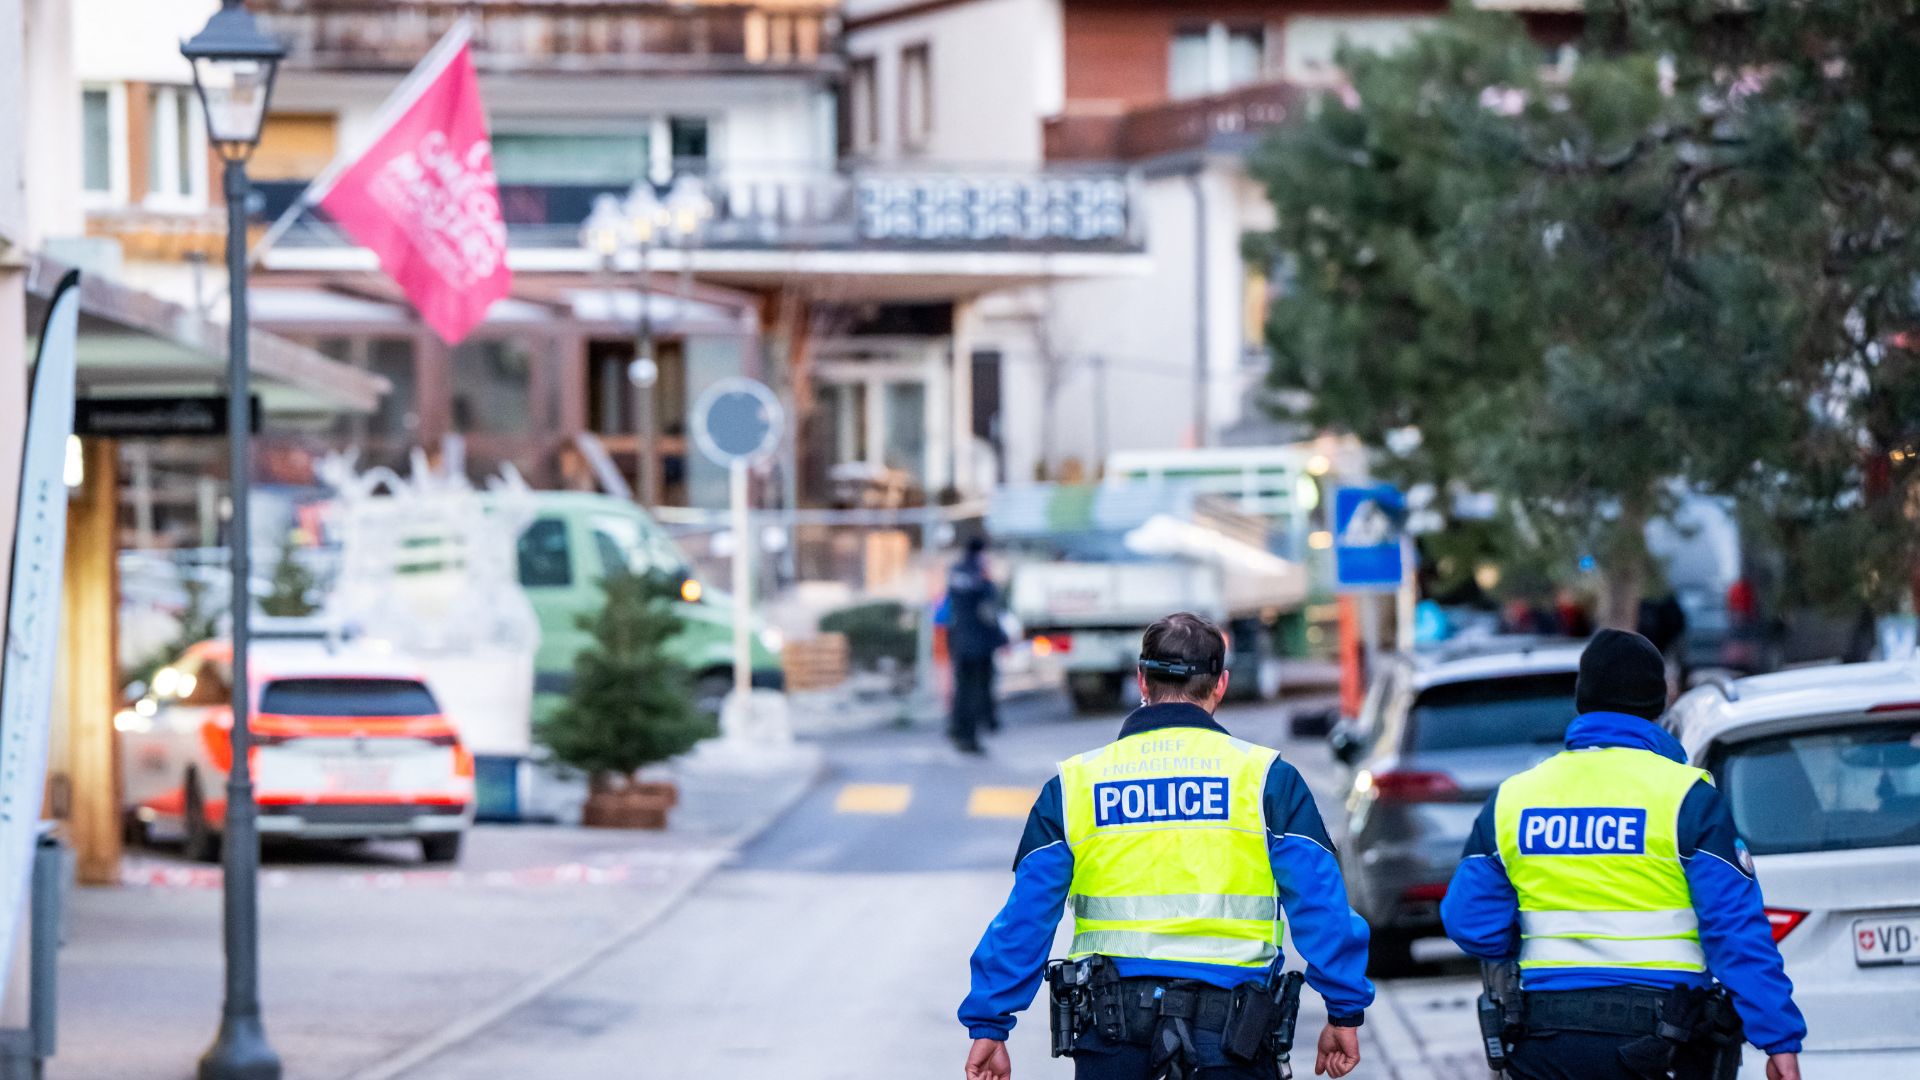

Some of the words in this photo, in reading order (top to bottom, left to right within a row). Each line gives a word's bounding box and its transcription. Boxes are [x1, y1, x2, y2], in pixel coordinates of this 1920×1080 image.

[1141, 739, 1185, 754] CHEF
[1103, 757, 1222, 776] ENGAGEMENT
[1099, 781, 1223, 820] POLICE
[1525, 815, 1637, 850] POLICE
